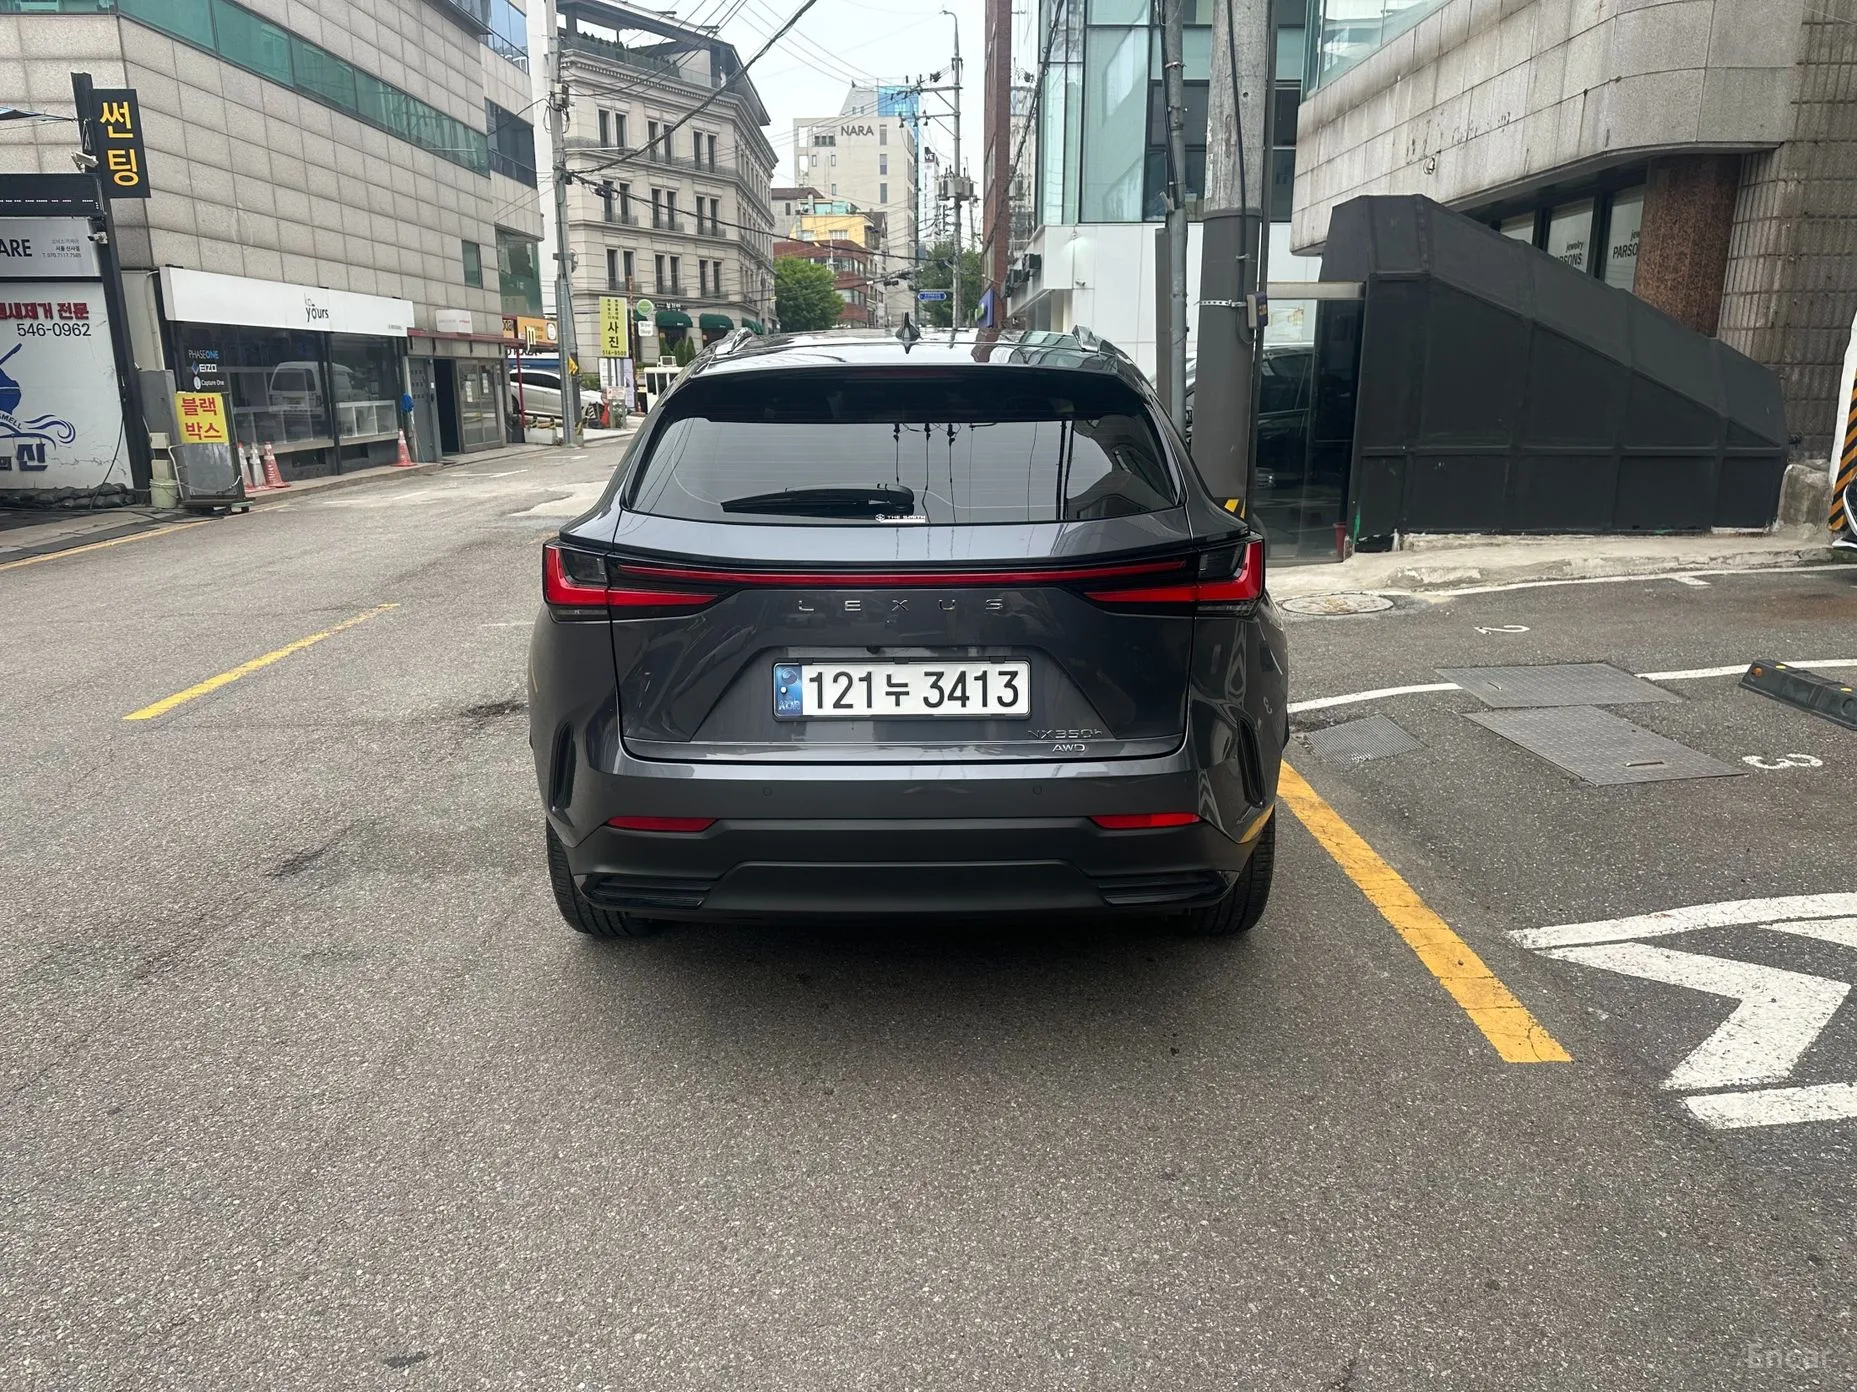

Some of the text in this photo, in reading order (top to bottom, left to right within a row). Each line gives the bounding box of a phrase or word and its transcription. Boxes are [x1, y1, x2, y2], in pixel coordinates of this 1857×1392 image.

[841, 124, 874, 137] NARA
[100, 101, 139, 187] 썬팅
[1566, 240, 1584, 253] jewelry
[57, 302, 89, 320] 전문
[305, 304, 329, 322] yours
[16, 322, 92, 337] 546-0962
[608, 321, 619, 348] 사진
[199, 363, 217, 372] EIZO
[201, 379, 216, 387] Capture
[181, 397, 218, 416] 블랙
[185, 422, 222, 440] 박스
[799, 598, 1003, 611] LEXUS
[808, 669, 1019, 709] 121누 3413
[1027, 729, 1103, 739] NX350h
[1052, 744, 1086, 752] AWD
